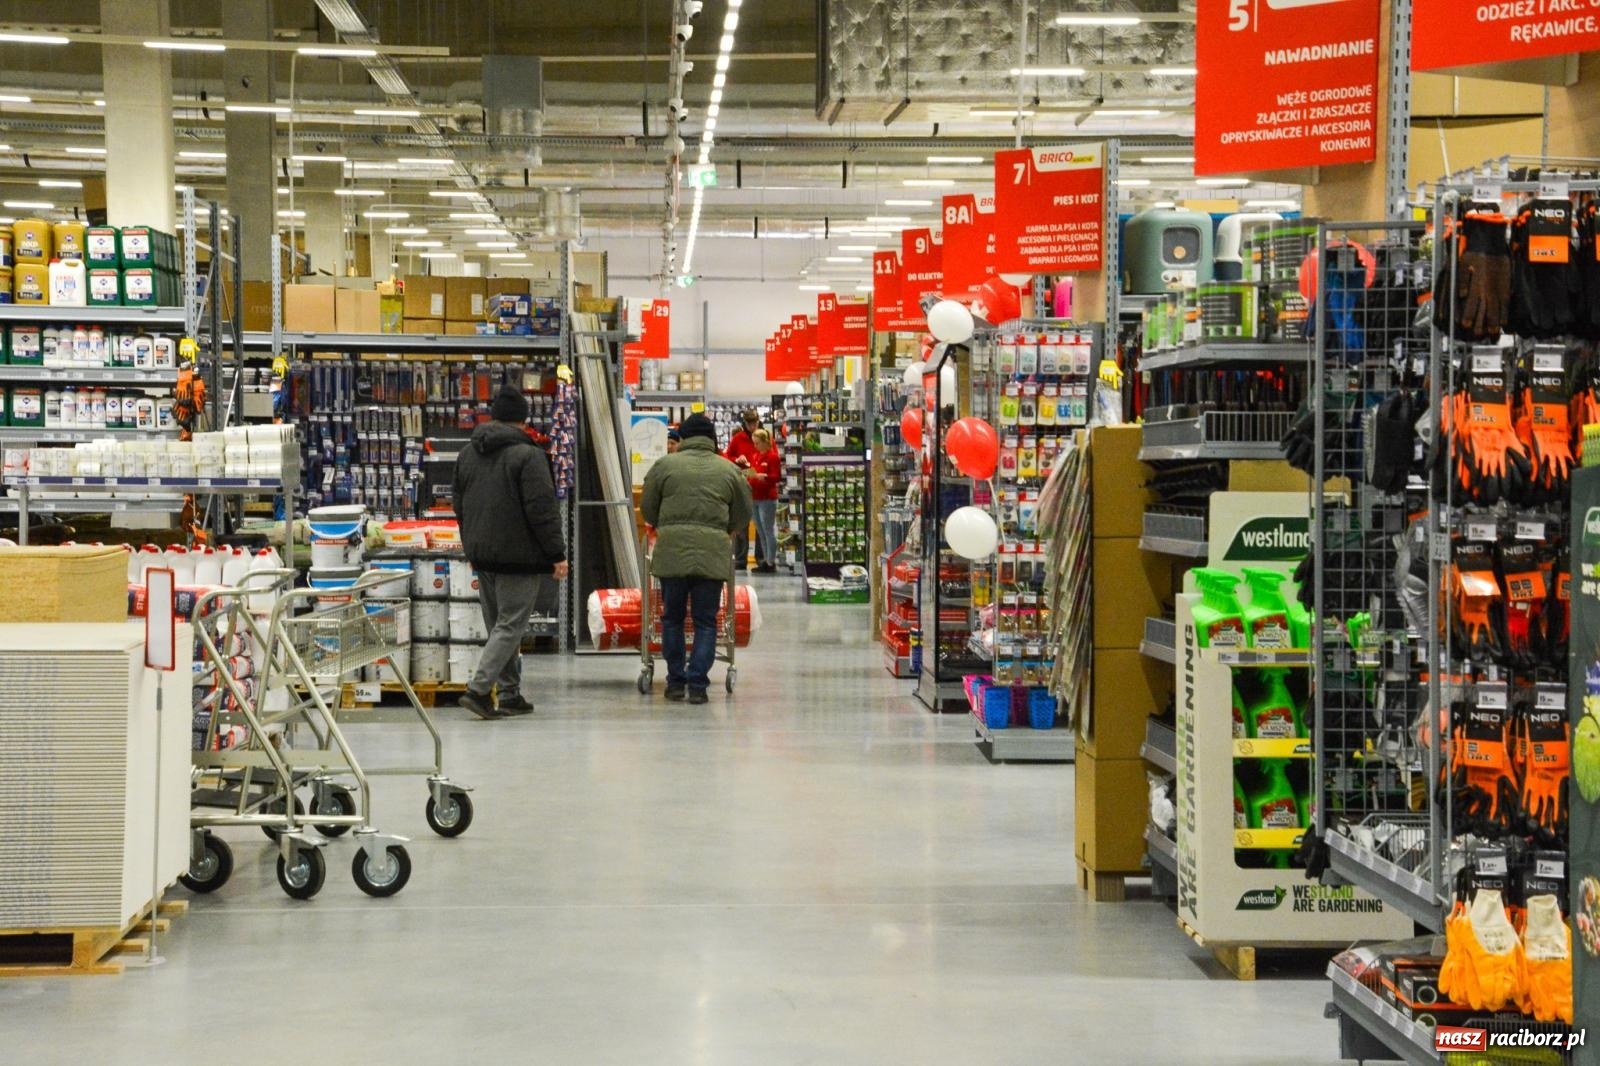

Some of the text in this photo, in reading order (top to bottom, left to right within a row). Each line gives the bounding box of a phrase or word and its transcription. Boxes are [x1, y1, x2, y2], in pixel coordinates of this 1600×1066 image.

[1228, 0, 1249, 31] 5
[1510, 16, 1599, 43] RĘKAWICE,
[1264, 39, 1374, 66] NAWADNIANIE
[1277, 84, 1372, 107] WĘŻE OGRODOWE
[1256, 102, 1372, 125] ZŁĄCZKI I ZRASZACZE
[1220, 119, 1371, 144] OPRYSKIWACZE I AKCESORIA
[1320, 136, 1371, 152] KONEWKI
[1039, 152, 1074, 164] BRICO
[1013, 163, 1026, 185] 7
[1053, 193, 1099, 206] PIES I KOT
[945, 206, 970, 225] 8A
[1535, 208, 1565, 218] NEO
[915, 237, 926, 254] 9
[876, 260, 892, 274] 11
[656, 305, 669, 317] 29
[820, 300, 833, 311] 13
[793, 319, 805, 330] 15
[781, 329, 792, 338] 17
[1473, 377, 1503, 387] NEO
[1533, 377, 1561, 386] NEO
[1456, 545, 1484, 554] NEO
[1503, 544, 1534, 556] NEO
[1470, 711, 1500, 722] NEO
[1530, 713, 1560, 723] NEO
[1185, 624, 1198, 921] ARE GARDENING
[1472, 880, 1504, 889] NEO
[1526, 881, 1558, 890] NEO
[1293, 884, 1353, 899] WESTLAND
[1243, 893, 1277, 905] westland
[1293, 899, 1383, 913] ARE GARDENING
